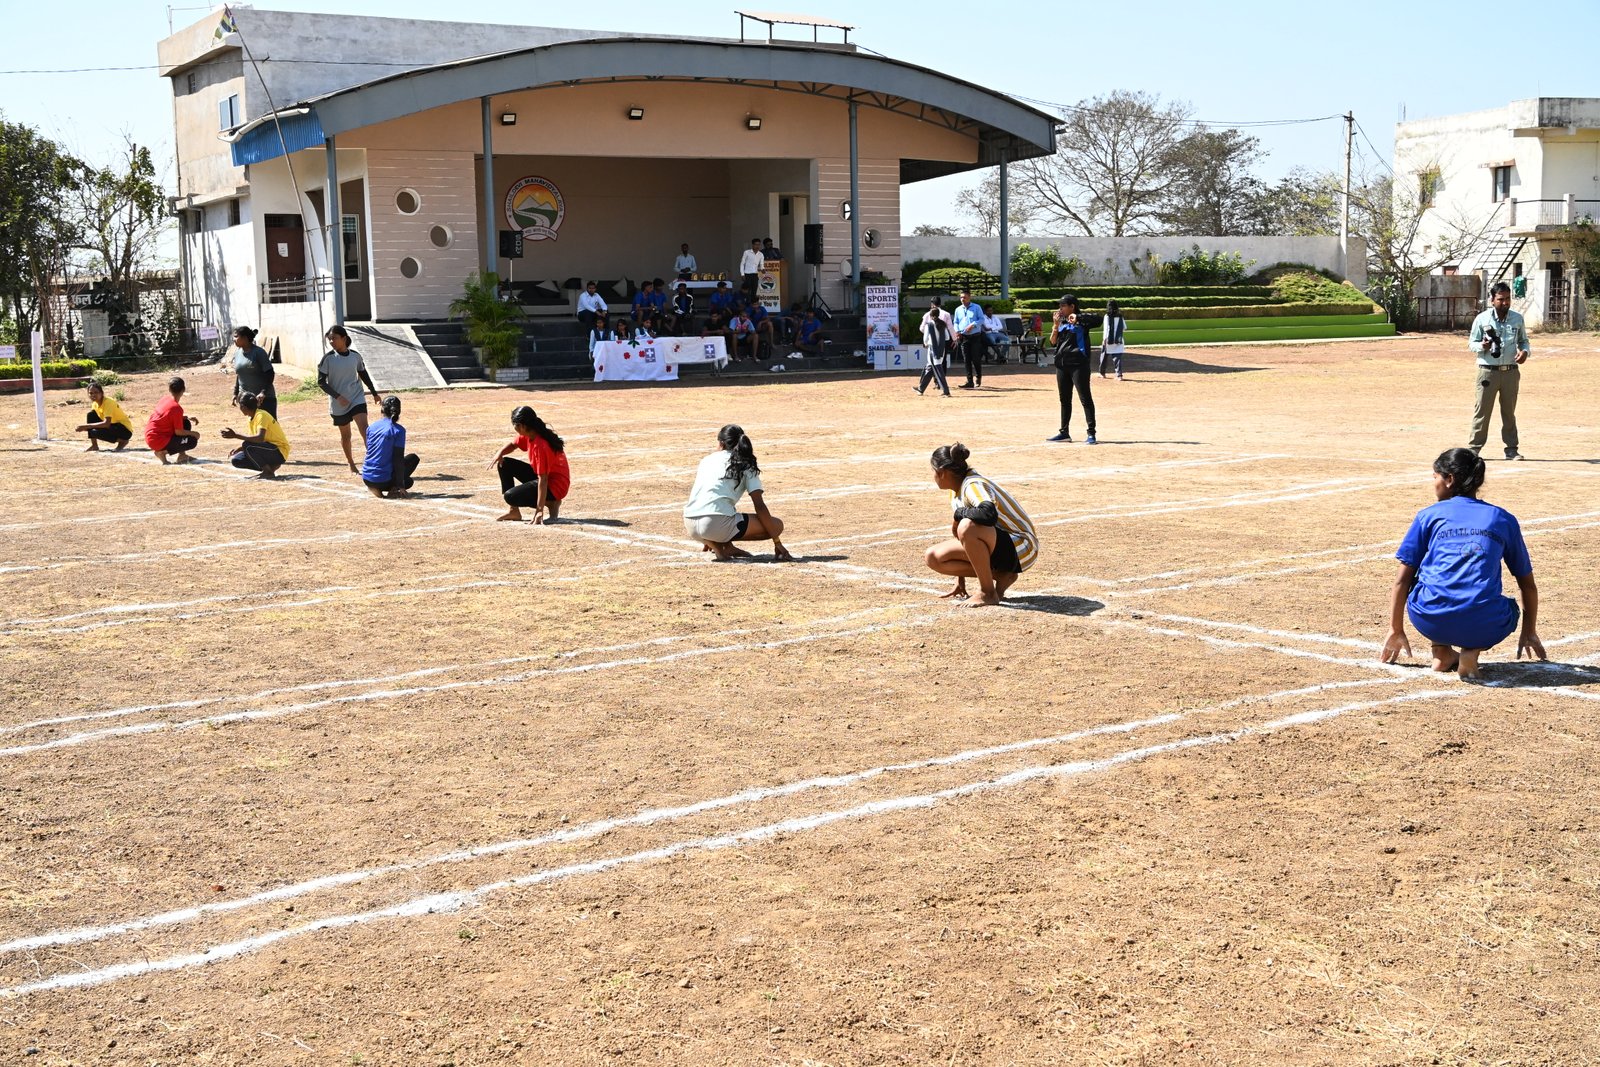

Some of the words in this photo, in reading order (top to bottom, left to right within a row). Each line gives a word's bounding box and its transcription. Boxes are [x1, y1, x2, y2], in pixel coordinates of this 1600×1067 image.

[887, 286, 897, 294] ITI
[867, 295, 897, 303] SPORTS
[914, 349, 920, 360] 1
[894, 354, 902, 366] 2
